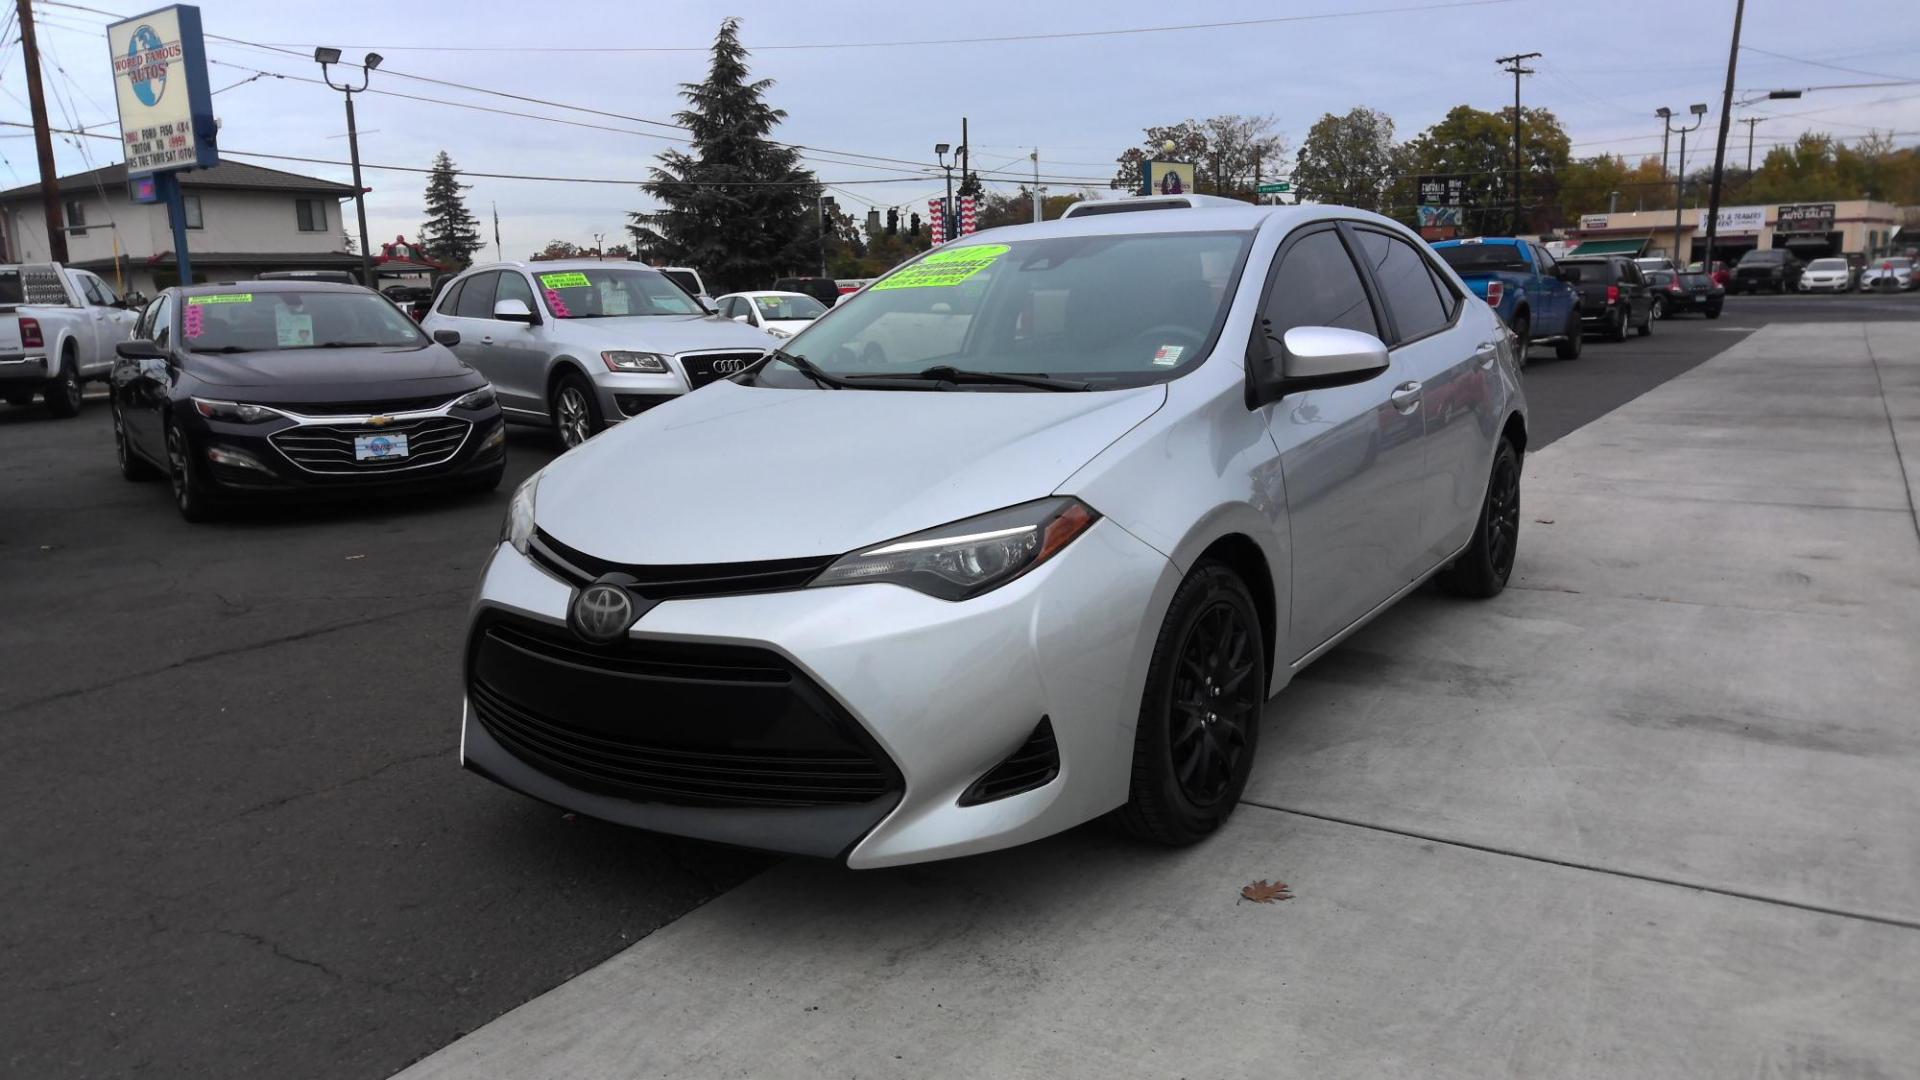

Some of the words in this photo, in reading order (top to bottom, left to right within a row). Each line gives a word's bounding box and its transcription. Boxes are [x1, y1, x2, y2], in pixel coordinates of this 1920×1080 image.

[115, 55, 143, 72] WORLD
[146, 45, 182, 63] FAMOUS
[165, 150, 176, 162] SAT
